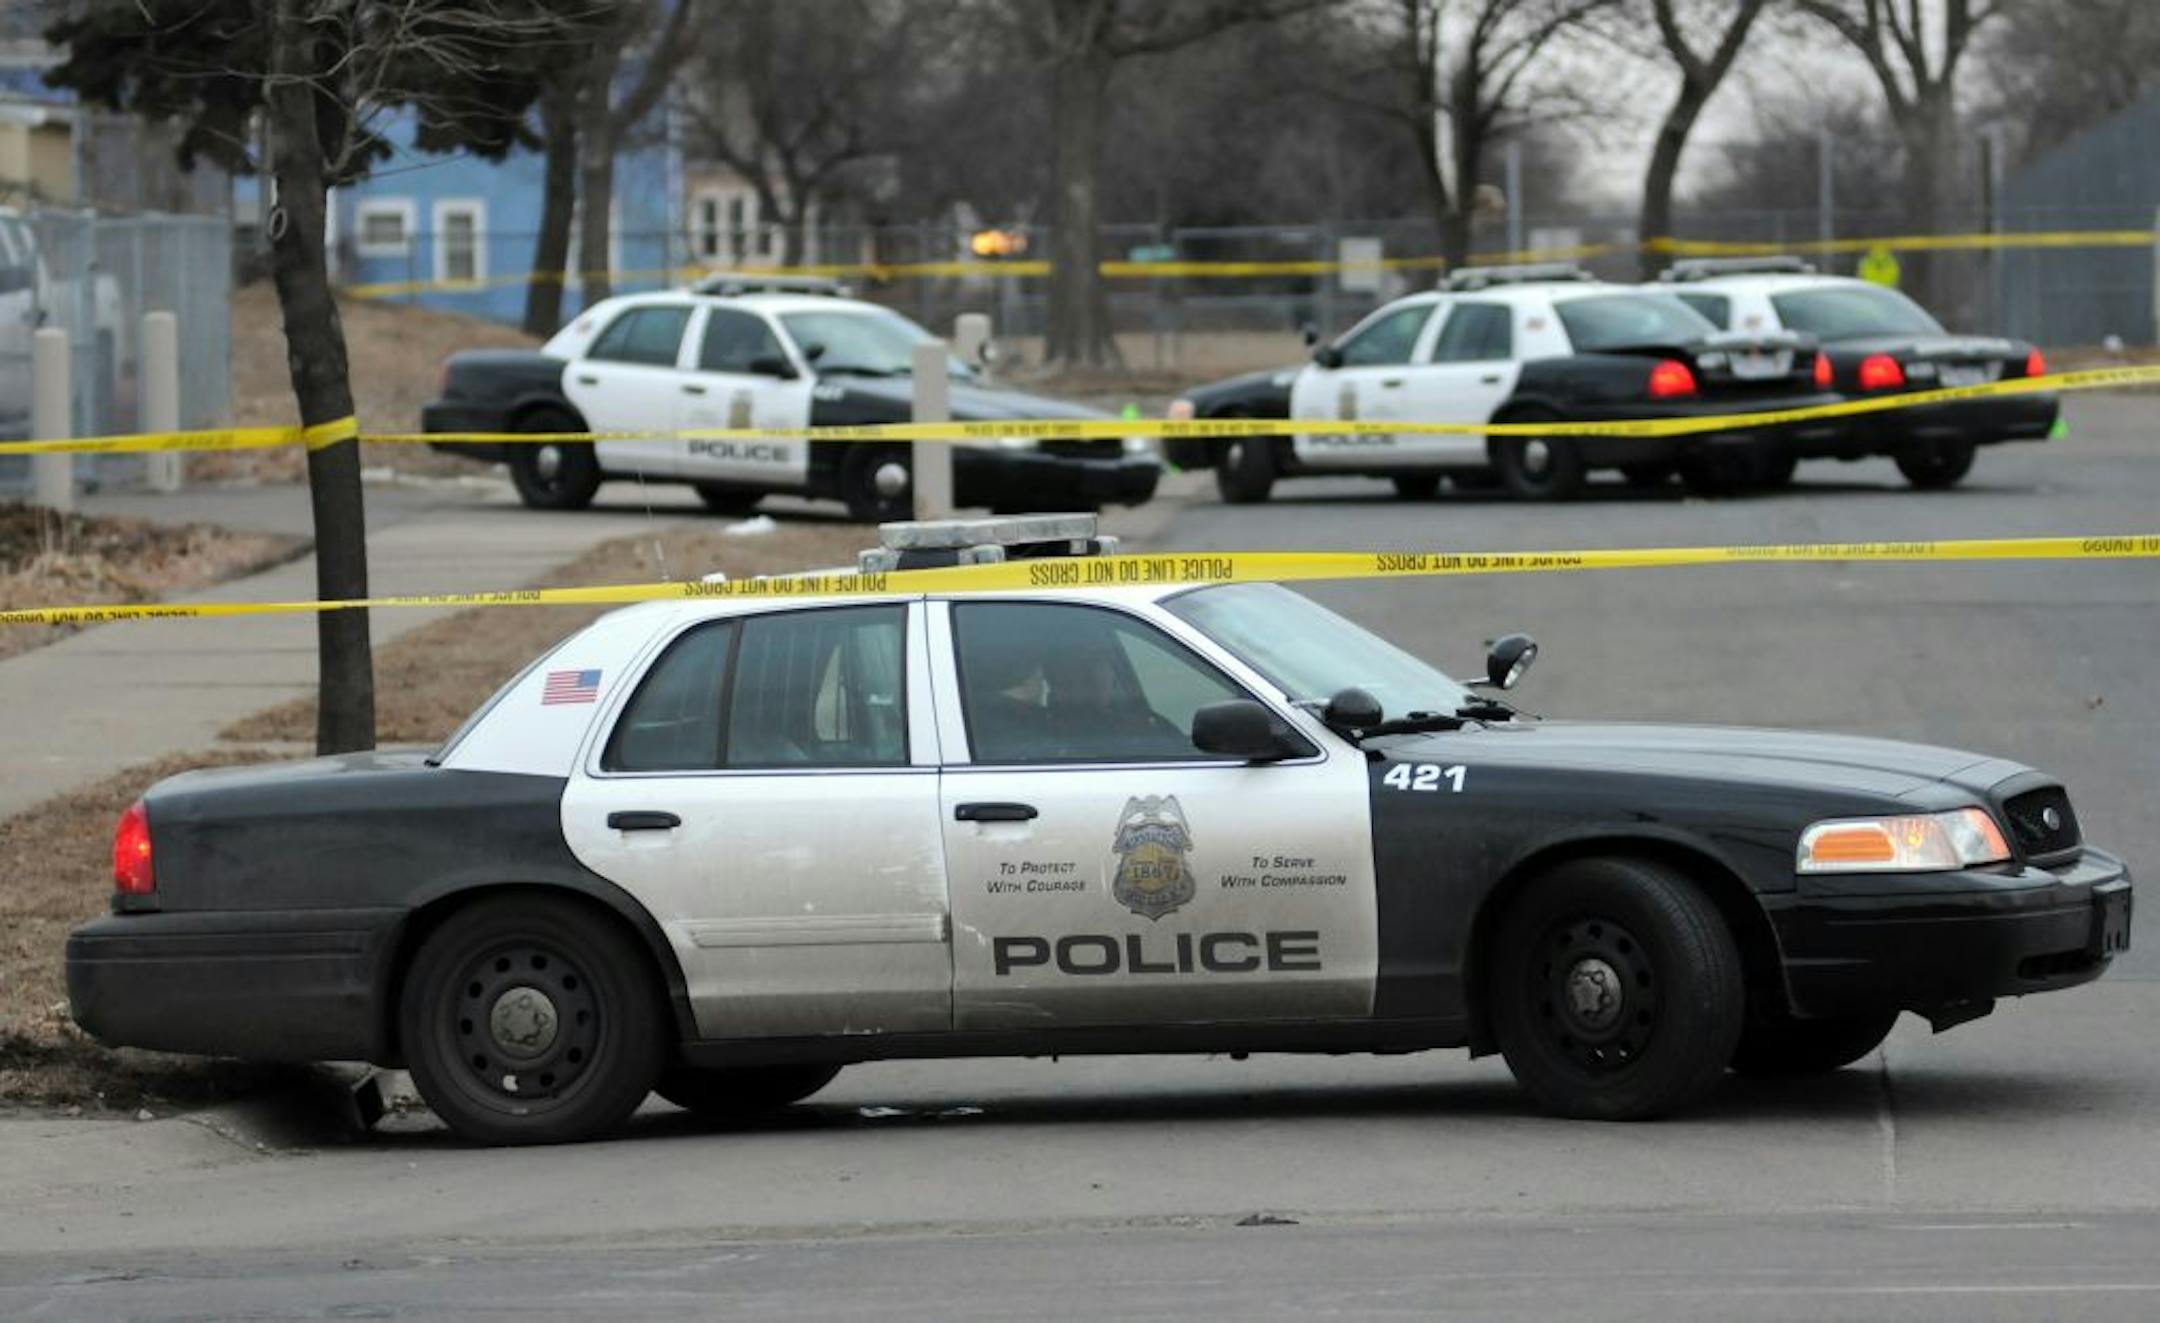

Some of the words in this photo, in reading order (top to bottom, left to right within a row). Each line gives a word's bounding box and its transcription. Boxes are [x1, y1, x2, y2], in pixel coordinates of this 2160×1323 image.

[688, 440, 790, 461] POLICE
[1087, 561, 1113, 583] NOT
[1119, 560, 1139, 581] DO
[1144, 559, 1175, 580] LINE
[1182, 558, 1233, 579] POLICE
[1376, 553, 1427, 571] CROSS
[836, 574, 886, 591] POLICE
[1030, 563, 1079, 585] CROSS
[685, 578, 733, 596] CROSS
[738, 579, 767, 594] NOT
[1383, 763, 1467, 792] 421
[993, 930, 1322, 976] POLICE
